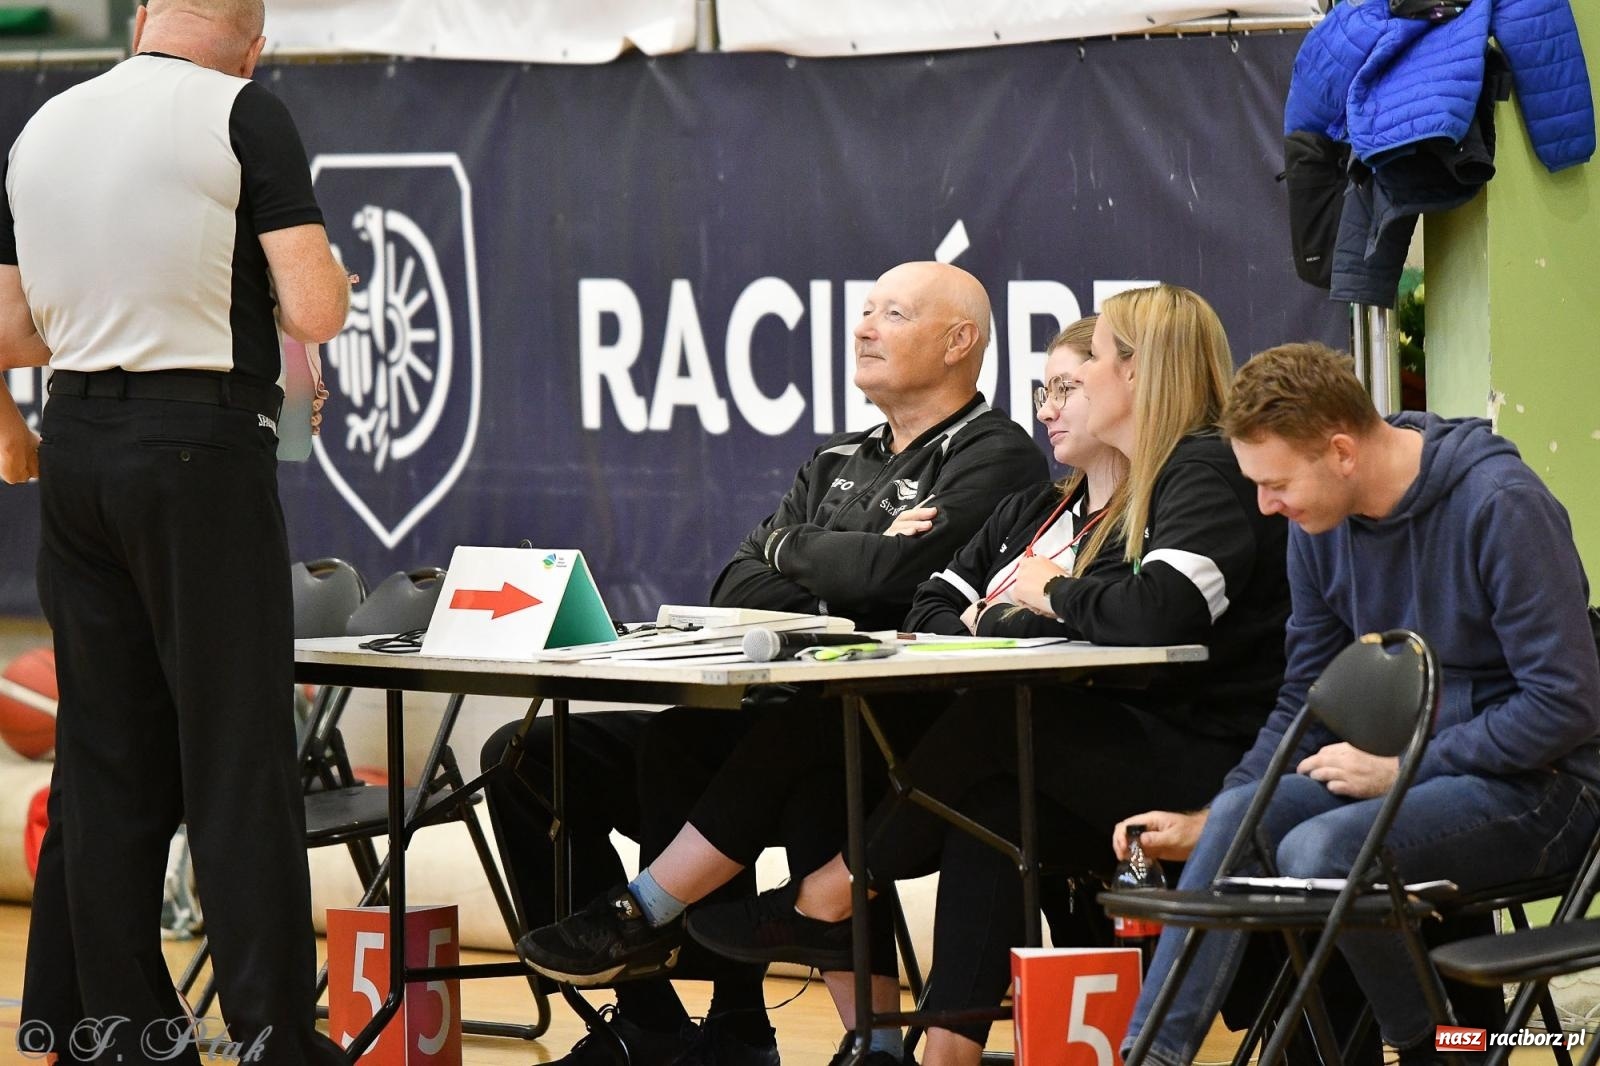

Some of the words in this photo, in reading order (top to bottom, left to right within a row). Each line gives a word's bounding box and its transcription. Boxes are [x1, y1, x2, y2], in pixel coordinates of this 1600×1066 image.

[341, 931, 384, 1056] 5
[417, 927, 452, 1055] 5
[1067, 973, 1118, 1066] 5
